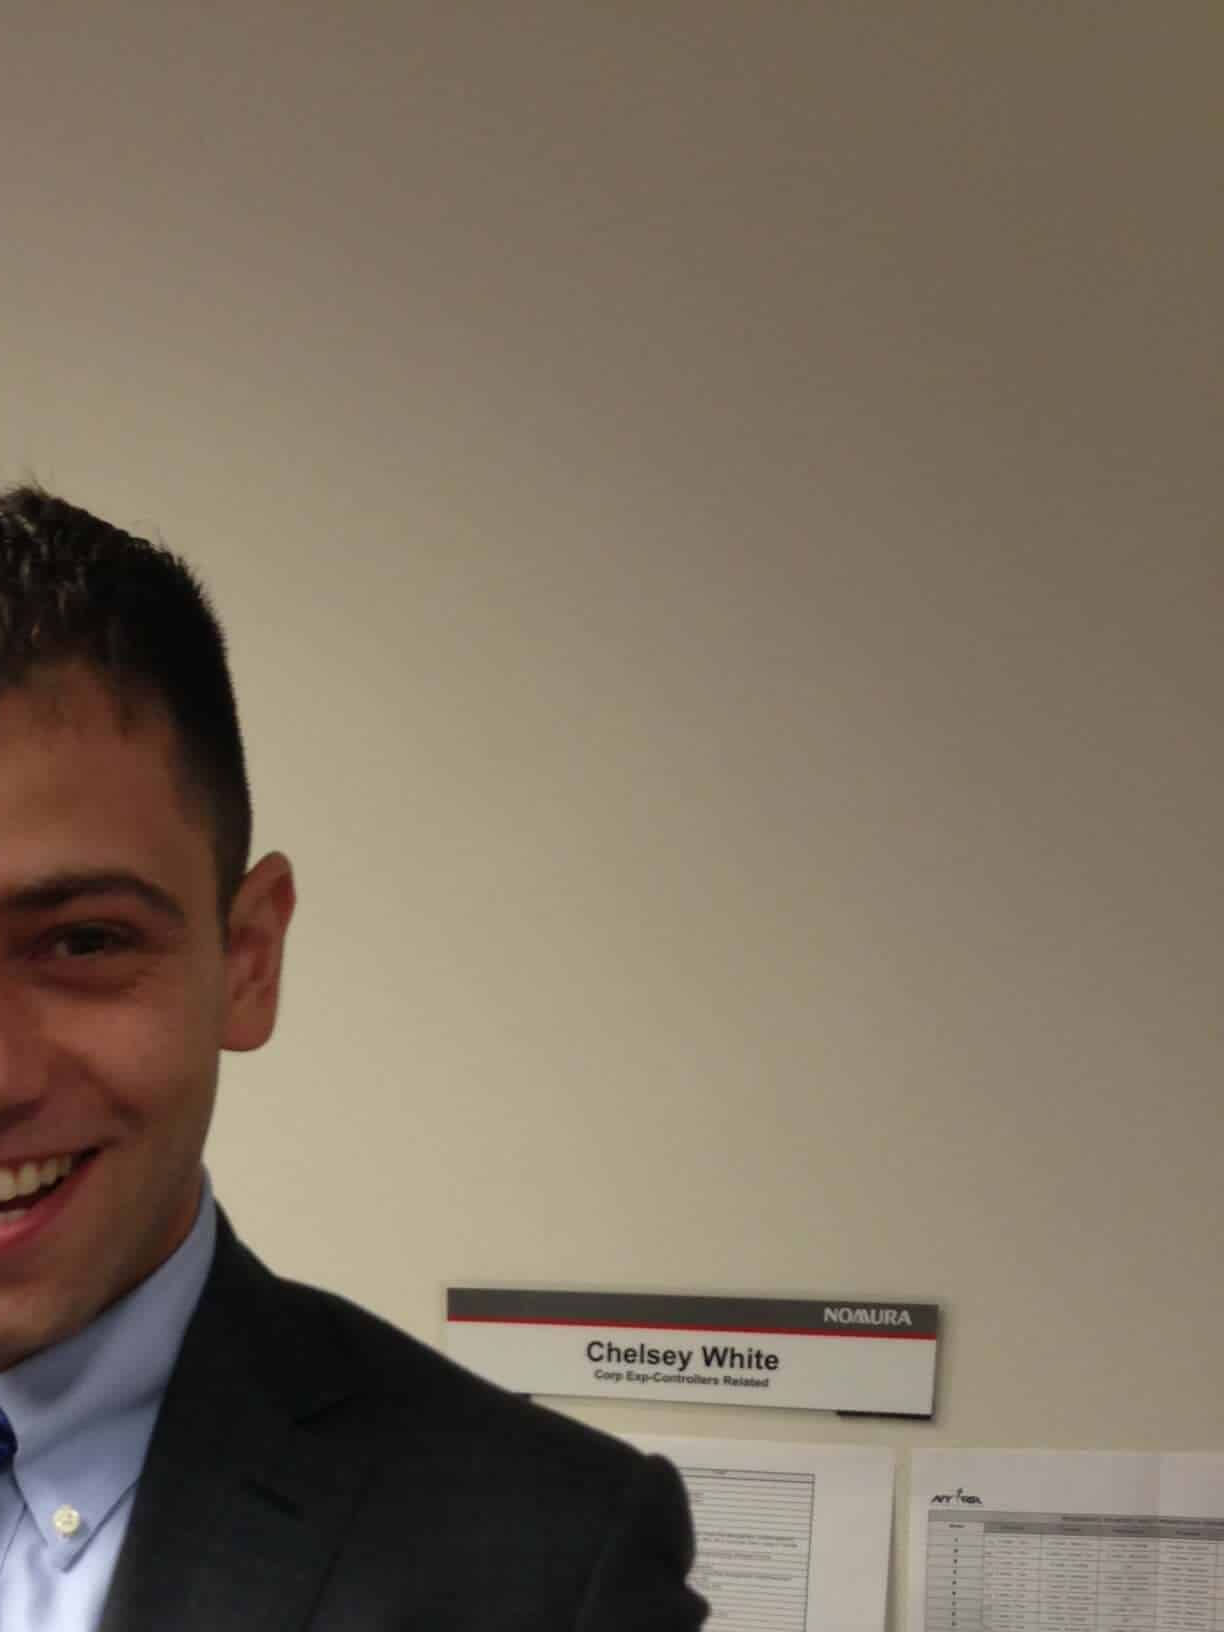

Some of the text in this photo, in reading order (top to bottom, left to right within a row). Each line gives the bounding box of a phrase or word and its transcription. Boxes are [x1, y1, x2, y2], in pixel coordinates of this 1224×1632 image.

[823, 1306, 912, 1326] NOMURA
[586, 1341, 780, 1372] Chelsey White
[593, 1369, 623, 1383] Corp
[722, 1375, 769, 1388] Related
